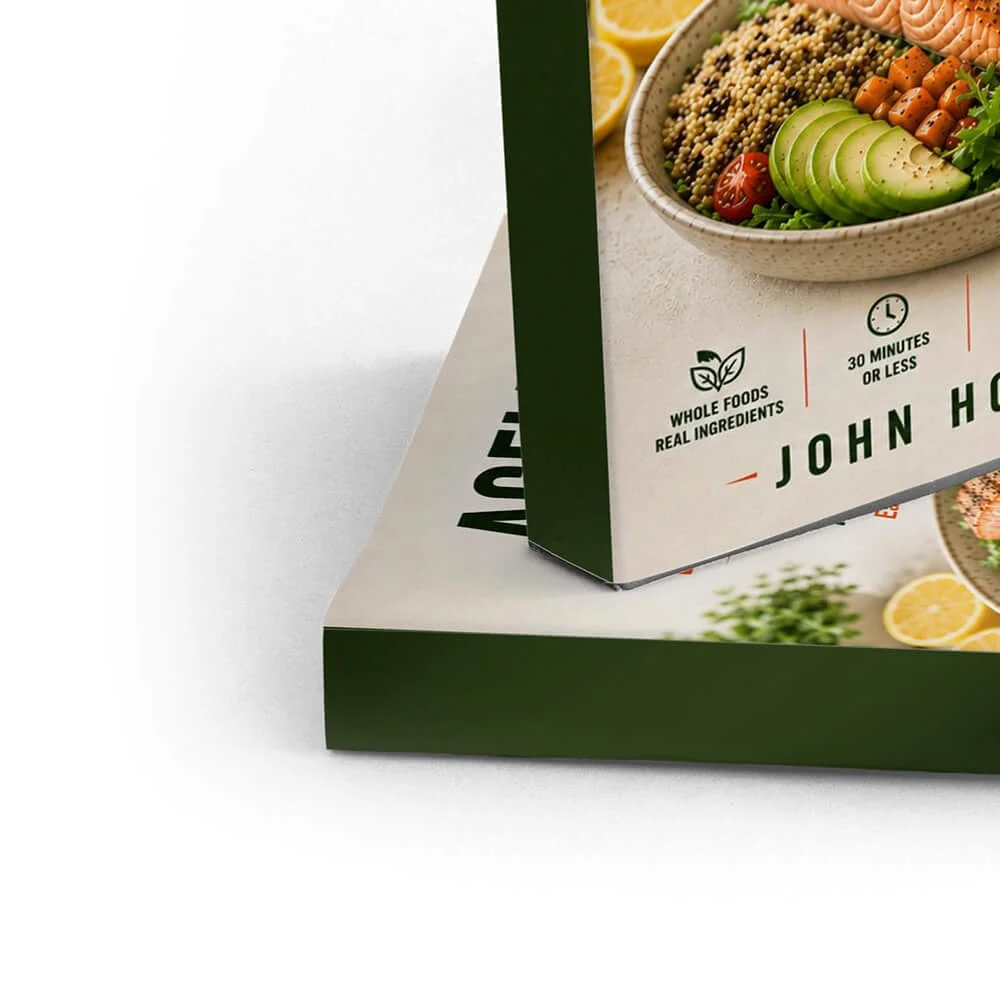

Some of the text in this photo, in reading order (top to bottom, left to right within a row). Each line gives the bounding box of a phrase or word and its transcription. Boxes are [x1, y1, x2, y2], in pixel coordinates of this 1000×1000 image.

[847, 331, 930, 371] 30 MINUTES
[862, 355, 918, 386] OR LESS
[655, 399, 785, 453] REAL INGREDIENTS
[670, 384, 769, 428] WHOLE FOODS
[775, 404, 912, 489] JOHN
